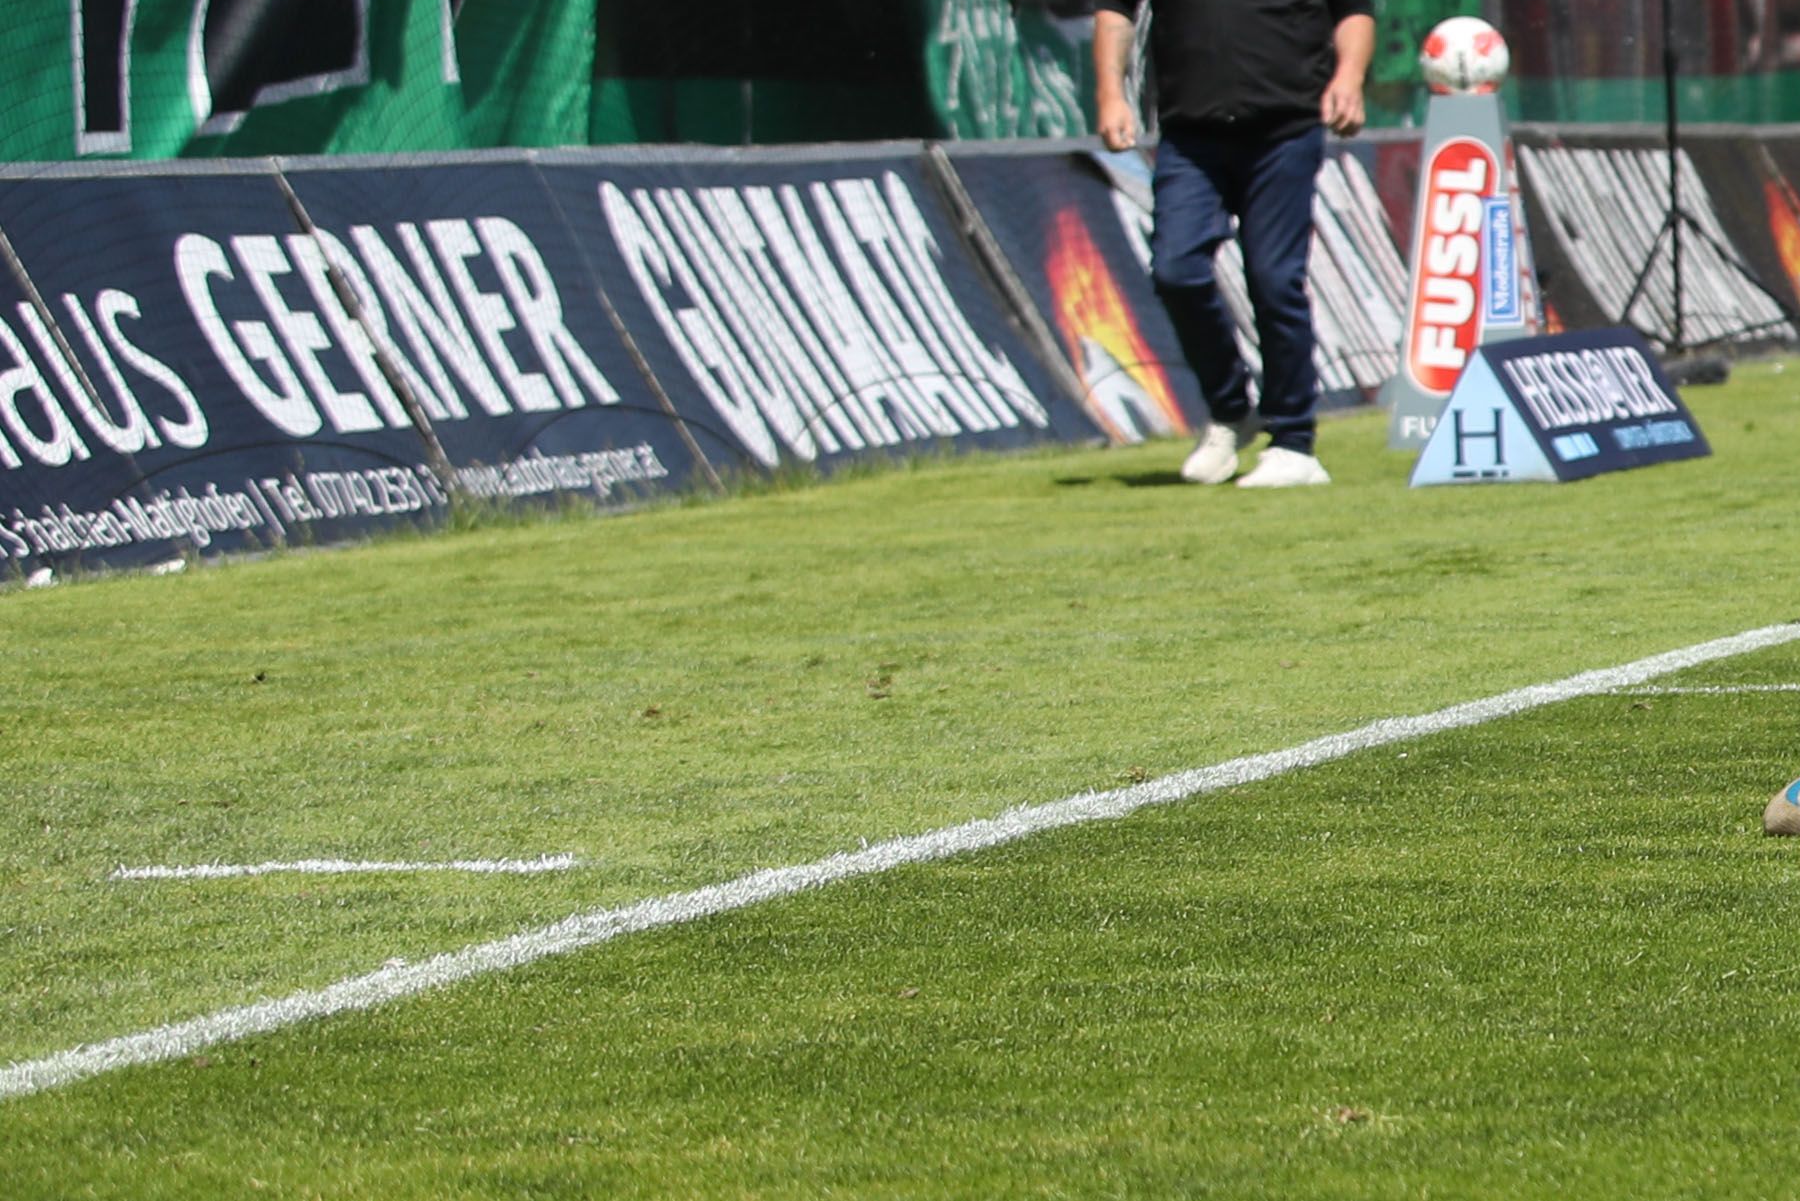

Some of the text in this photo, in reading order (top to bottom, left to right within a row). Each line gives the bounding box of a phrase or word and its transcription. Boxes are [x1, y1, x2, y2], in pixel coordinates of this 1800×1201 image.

[0, 216, 620, 469] aus GERNER
[598, 169, 1050, 469] GUNTAMATIC
[1418, 157, 1488, 369] FUSSL
[260, 472, 324, 524] Tel.
[1452, 407, 1505, 467] H
